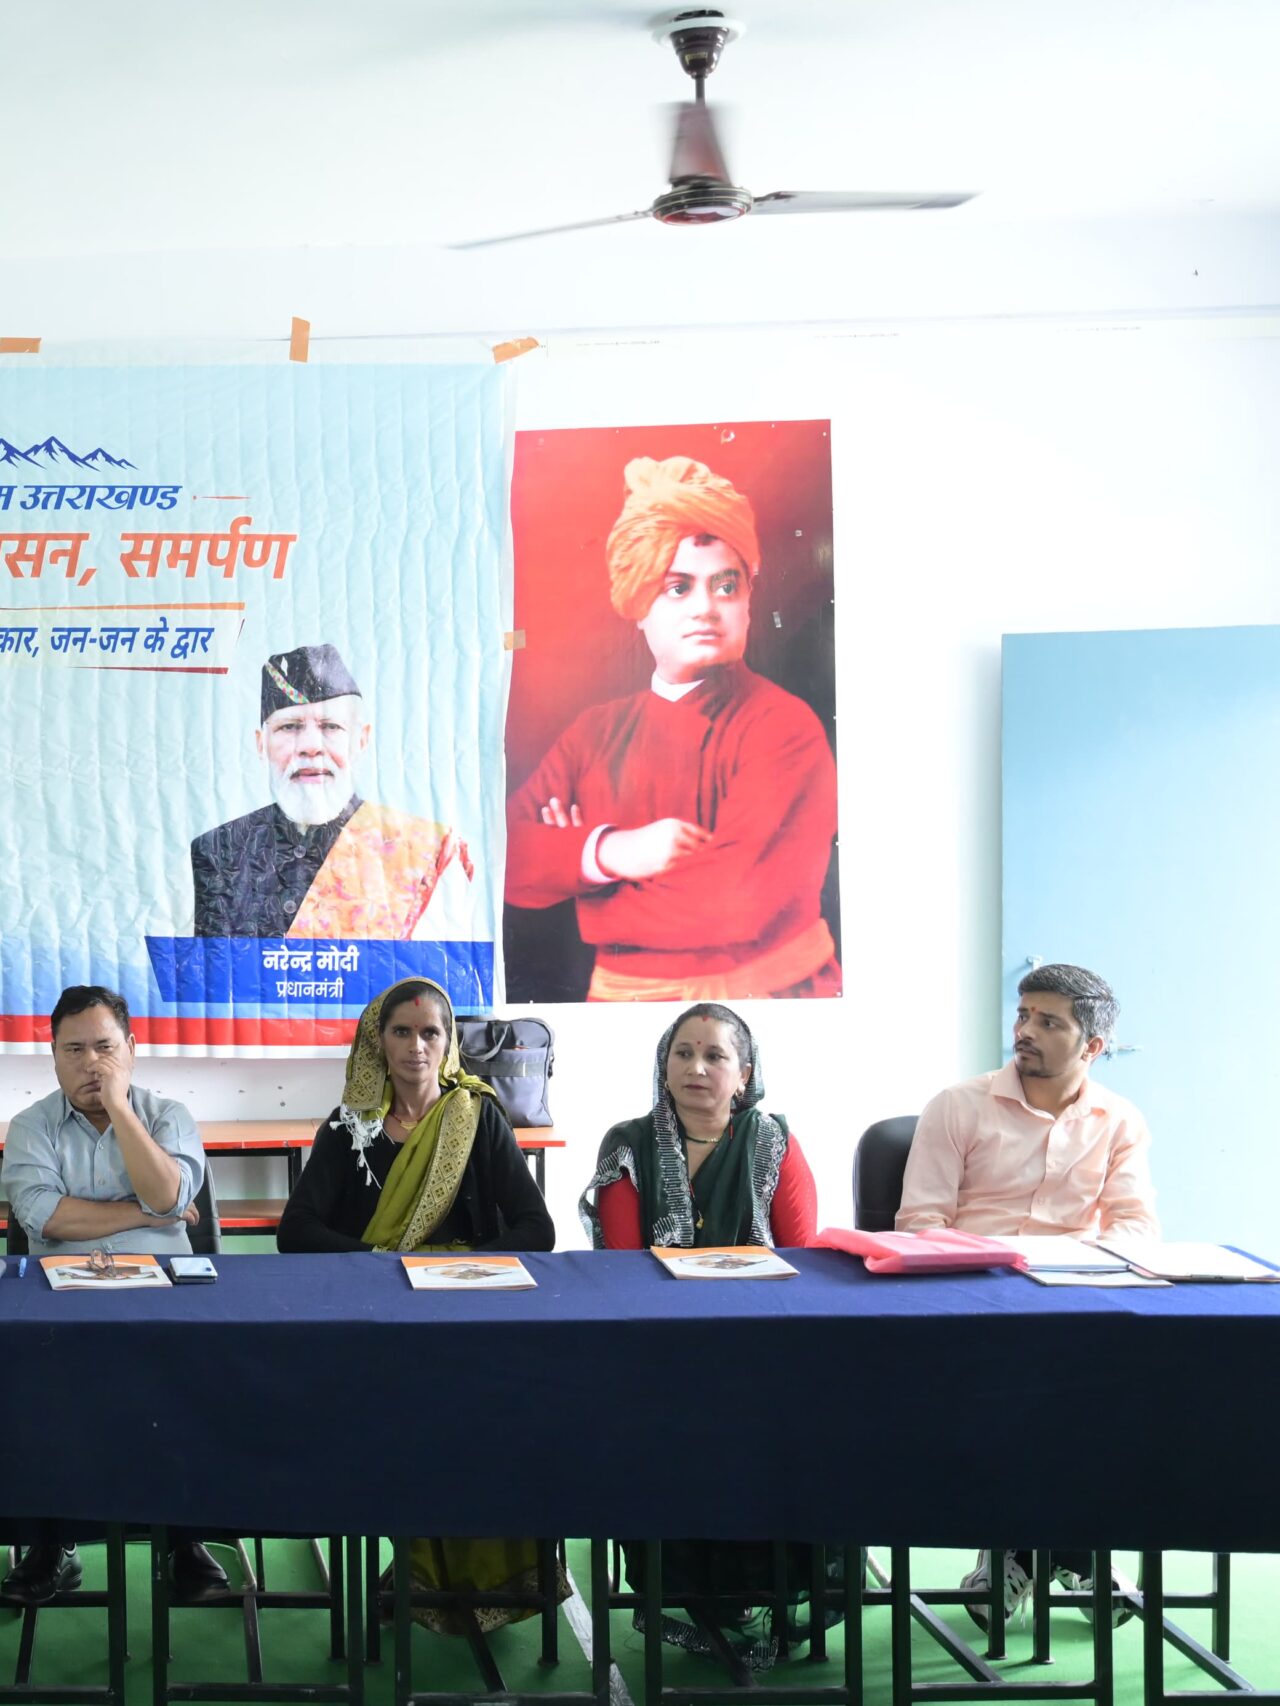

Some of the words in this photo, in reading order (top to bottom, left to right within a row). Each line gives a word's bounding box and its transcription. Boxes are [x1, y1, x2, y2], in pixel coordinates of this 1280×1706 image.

[19, 484, 182, 511] उत्तराखण्ड
[120, 516, 297, 579] समर्पण
[50, 627, 140, 653] जन-जन
[144, 616, 170, 653] के
[170, 627, 215, 660] द्वार
[262, 944, 313, 972] नरेन्द्र
[316, 944, 360, 972] मोदी
[276, 976, 345, 999] प्रधानमंत्री
